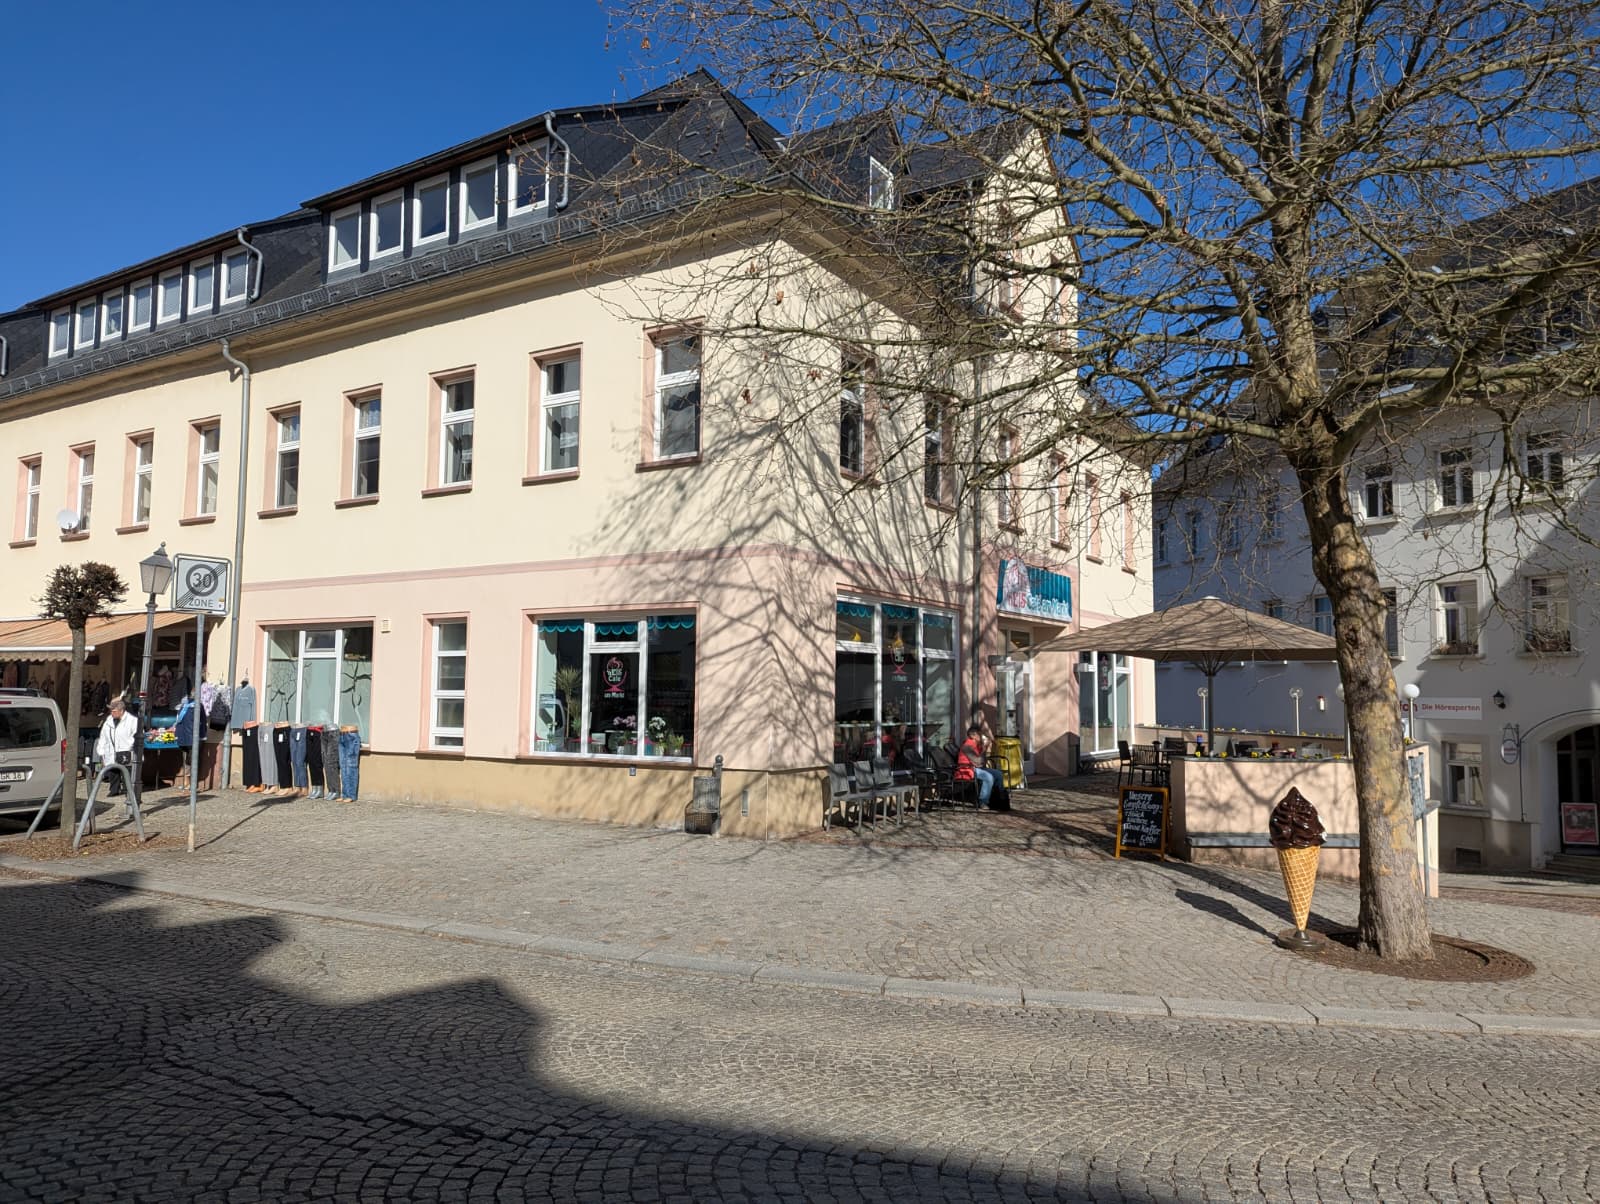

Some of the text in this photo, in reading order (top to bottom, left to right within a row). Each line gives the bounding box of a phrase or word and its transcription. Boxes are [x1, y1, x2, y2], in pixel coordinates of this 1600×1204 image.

[193, 572, 212, 588] 30
[189, 598, 213, 607] ZONE
[1422, 703, 1433, 711] Die
